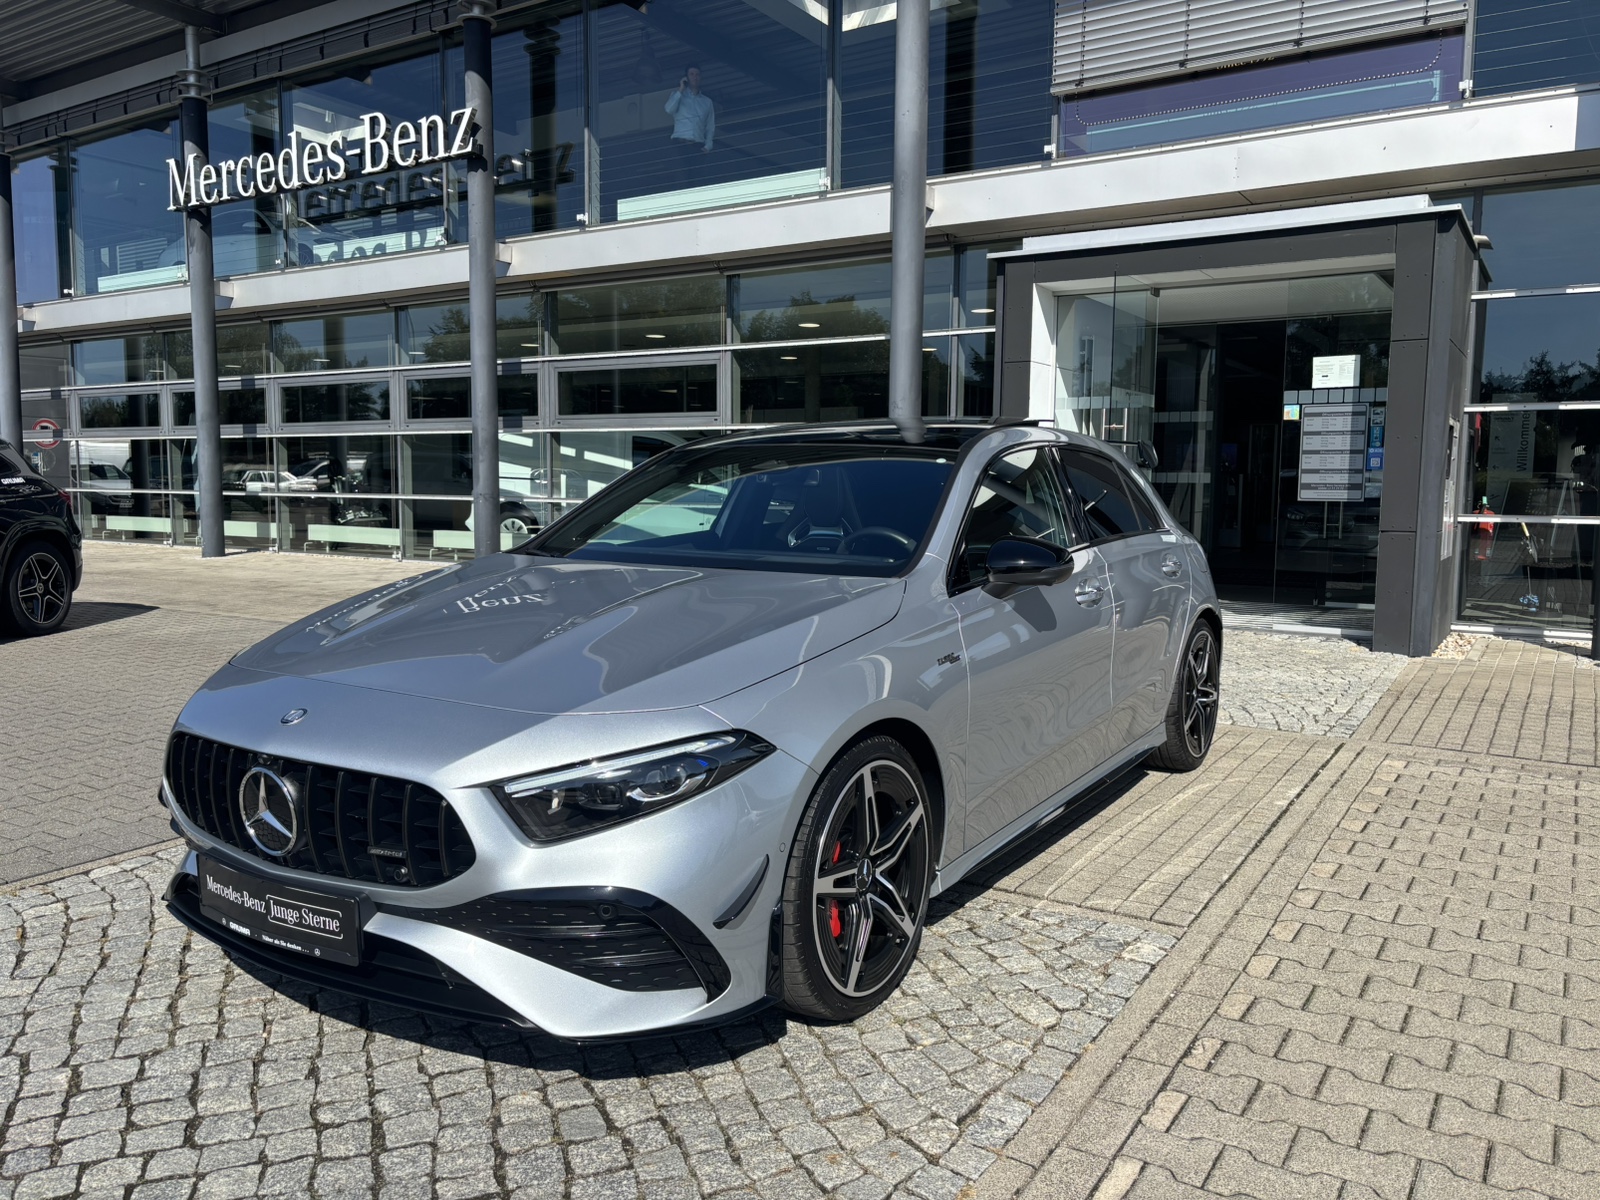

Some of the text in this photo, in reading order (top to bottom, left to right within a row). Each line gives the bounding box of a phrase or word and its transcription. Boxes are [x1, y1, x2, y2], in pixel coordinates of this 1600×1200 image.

[166, 106, 477, 212] Mercedes-Benz
[206, 874, 340, 932] Mercedes-Benz Junge Sterne
